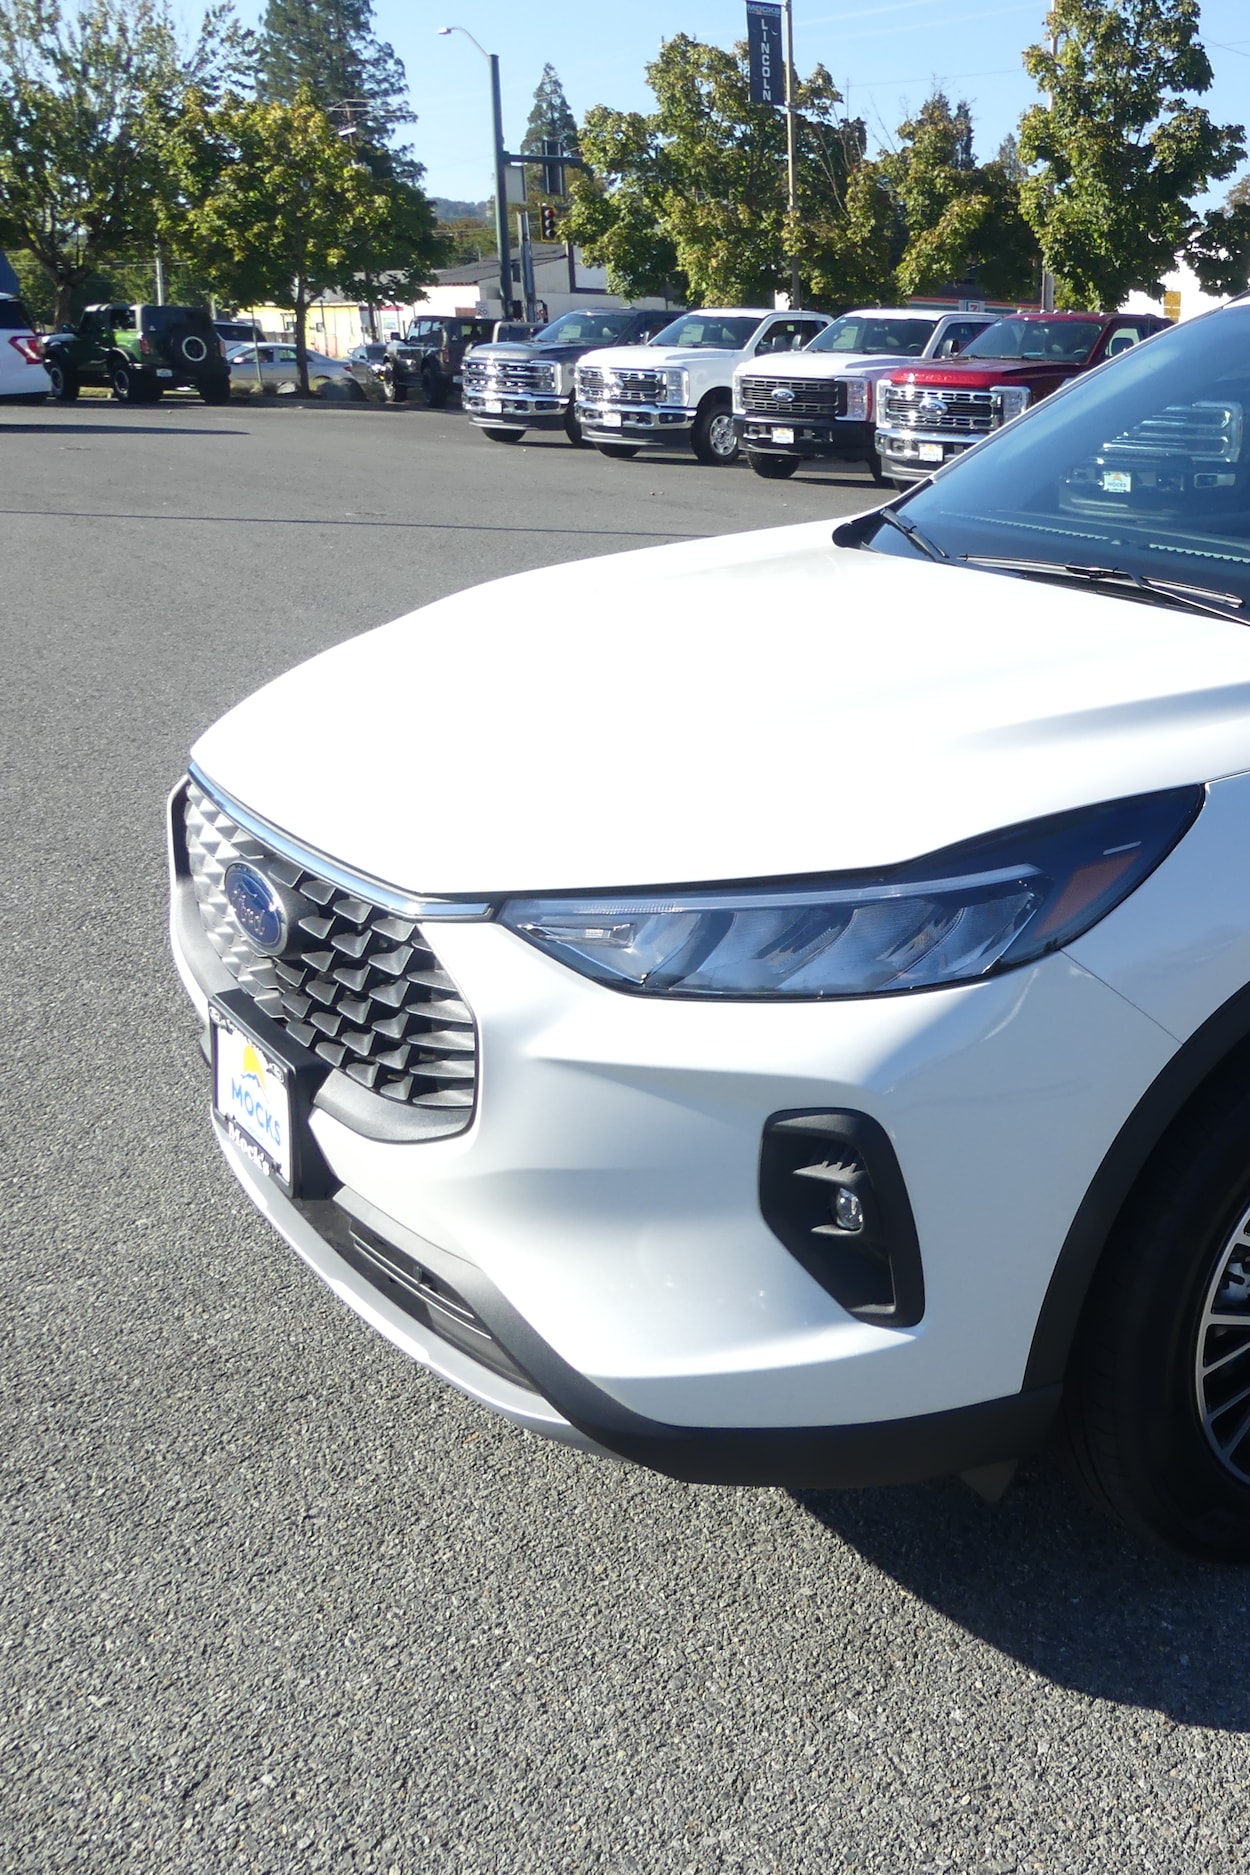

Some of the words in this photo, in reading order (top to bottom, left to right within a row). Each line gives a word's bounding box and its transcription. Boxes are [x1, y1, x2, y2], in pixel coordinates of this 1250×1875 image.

[761, 19, 771, 101] LINCOLN
[228, 879, 267, 936] Ford
[231, 1076, 282, 1148] MOCKS
